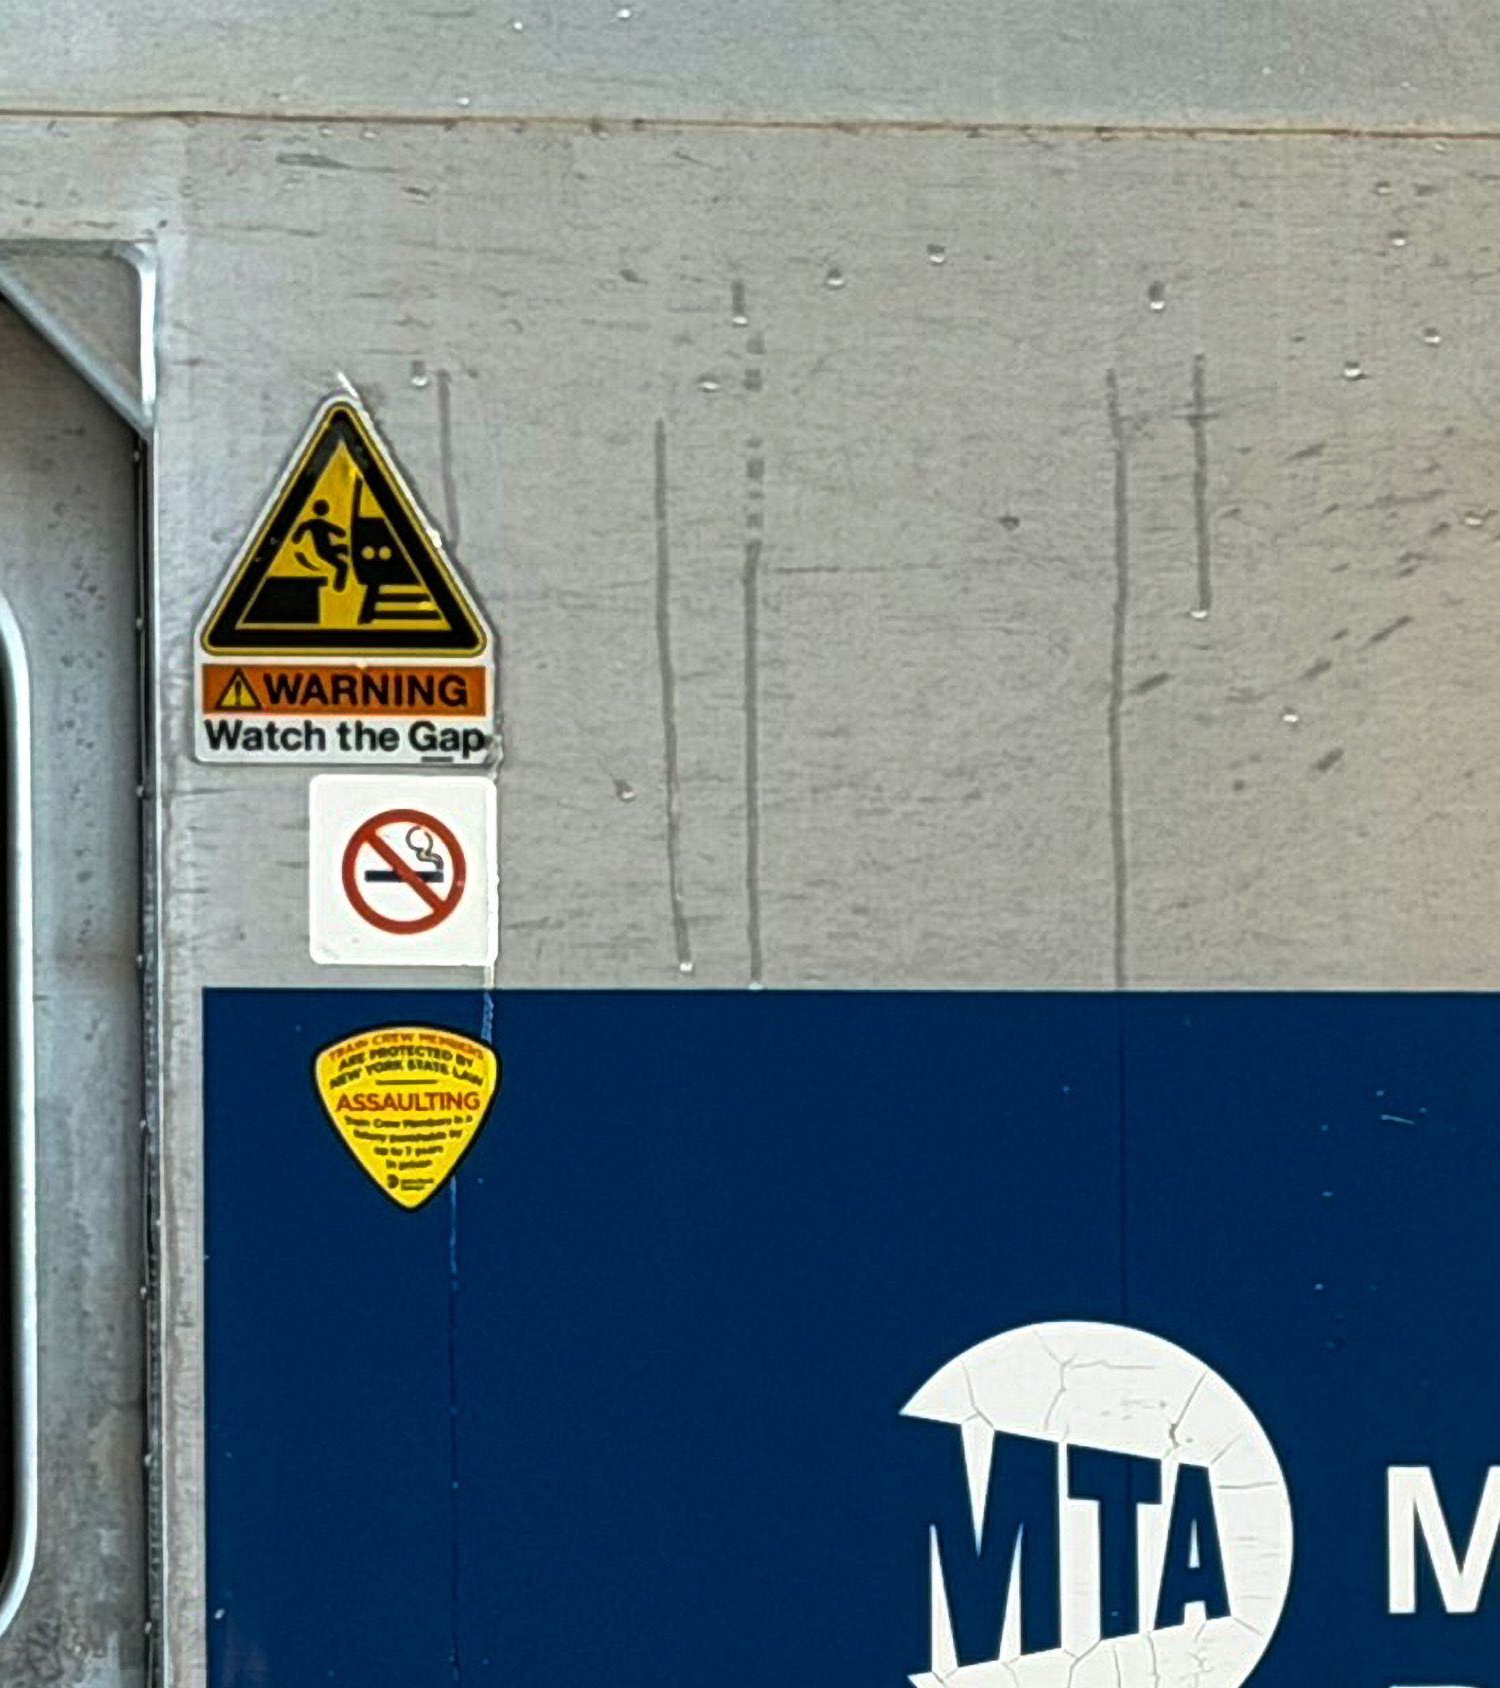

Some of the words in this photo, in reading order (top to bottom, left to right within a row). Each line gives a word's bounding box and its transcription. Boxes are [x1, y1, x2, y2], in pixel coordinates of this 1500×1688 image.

[263, 673, 468, 707] WARNING
[204, 719, 326, 752] Watch
[336, 721, 400, 752] the
[409, 721, 486, 759] Gap
[339, 1053, 365, 1070] ARE
[369, 1045, 454, 1061] PROTECTED
[336, 1092, 480, 1111] ASSAULTING
[930, 1423, 1231, 1674] MTA
